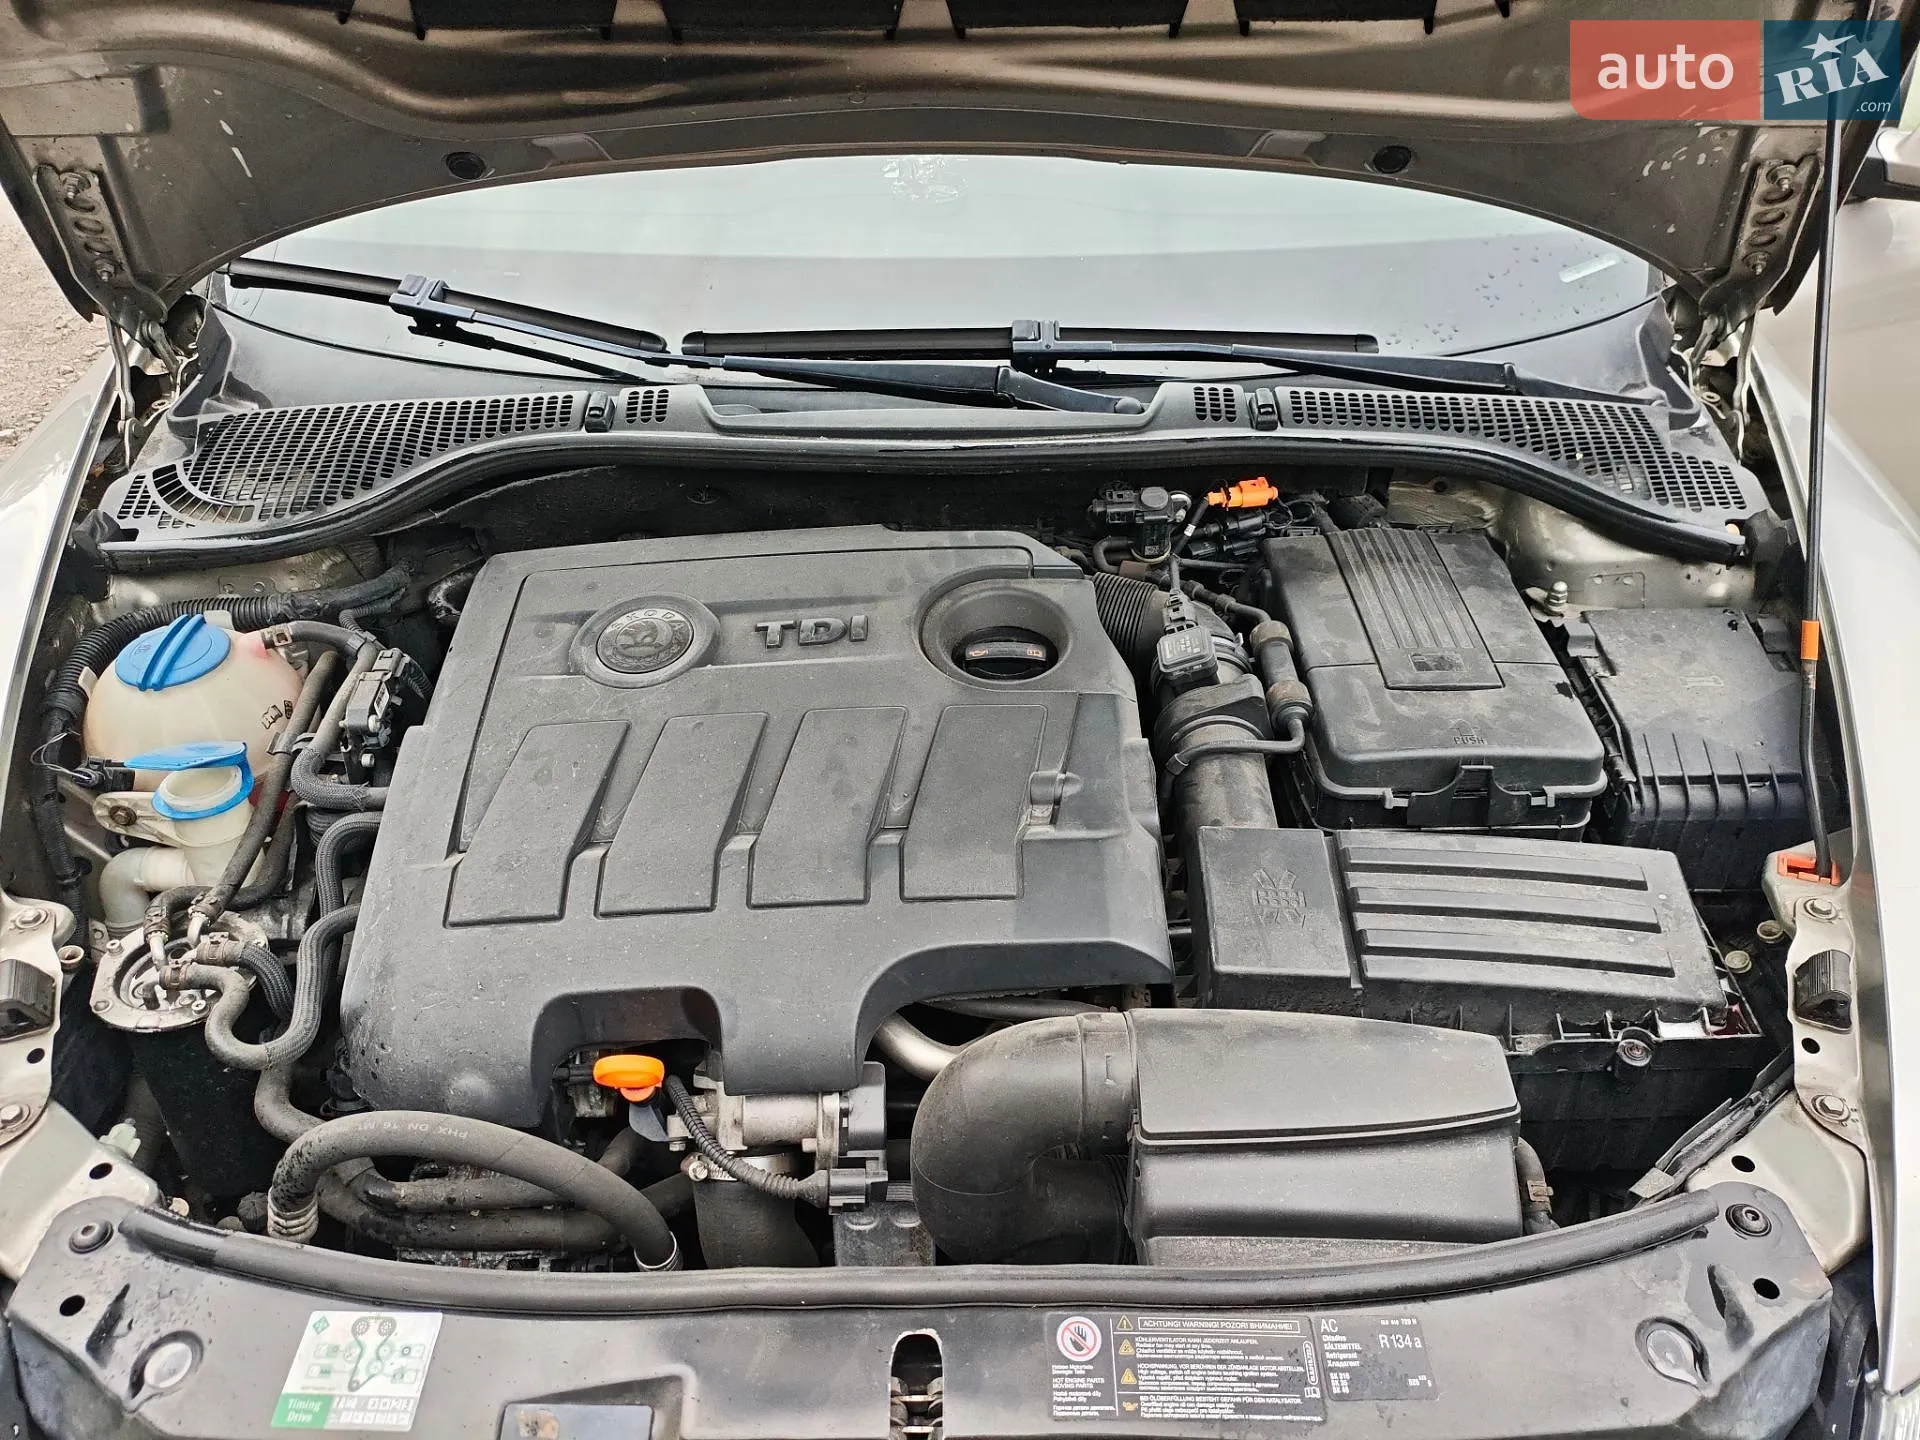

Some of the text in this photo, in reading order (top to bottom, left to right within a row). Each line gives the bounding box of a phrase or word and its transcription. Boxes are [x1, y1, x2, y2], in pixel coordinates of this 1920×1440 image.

[754, 615, 868, 649] TDI
[1453, 736, 1486, 745] PUSH
[1320, 1318, 1339, 1333] AC
[1378, 1333, 1390, 1349] R
[1390, 1333, 1413, 1349] 134
[287, 1398, 322, 1412] Timing
[286, 1412, 314, 1423] Drive
